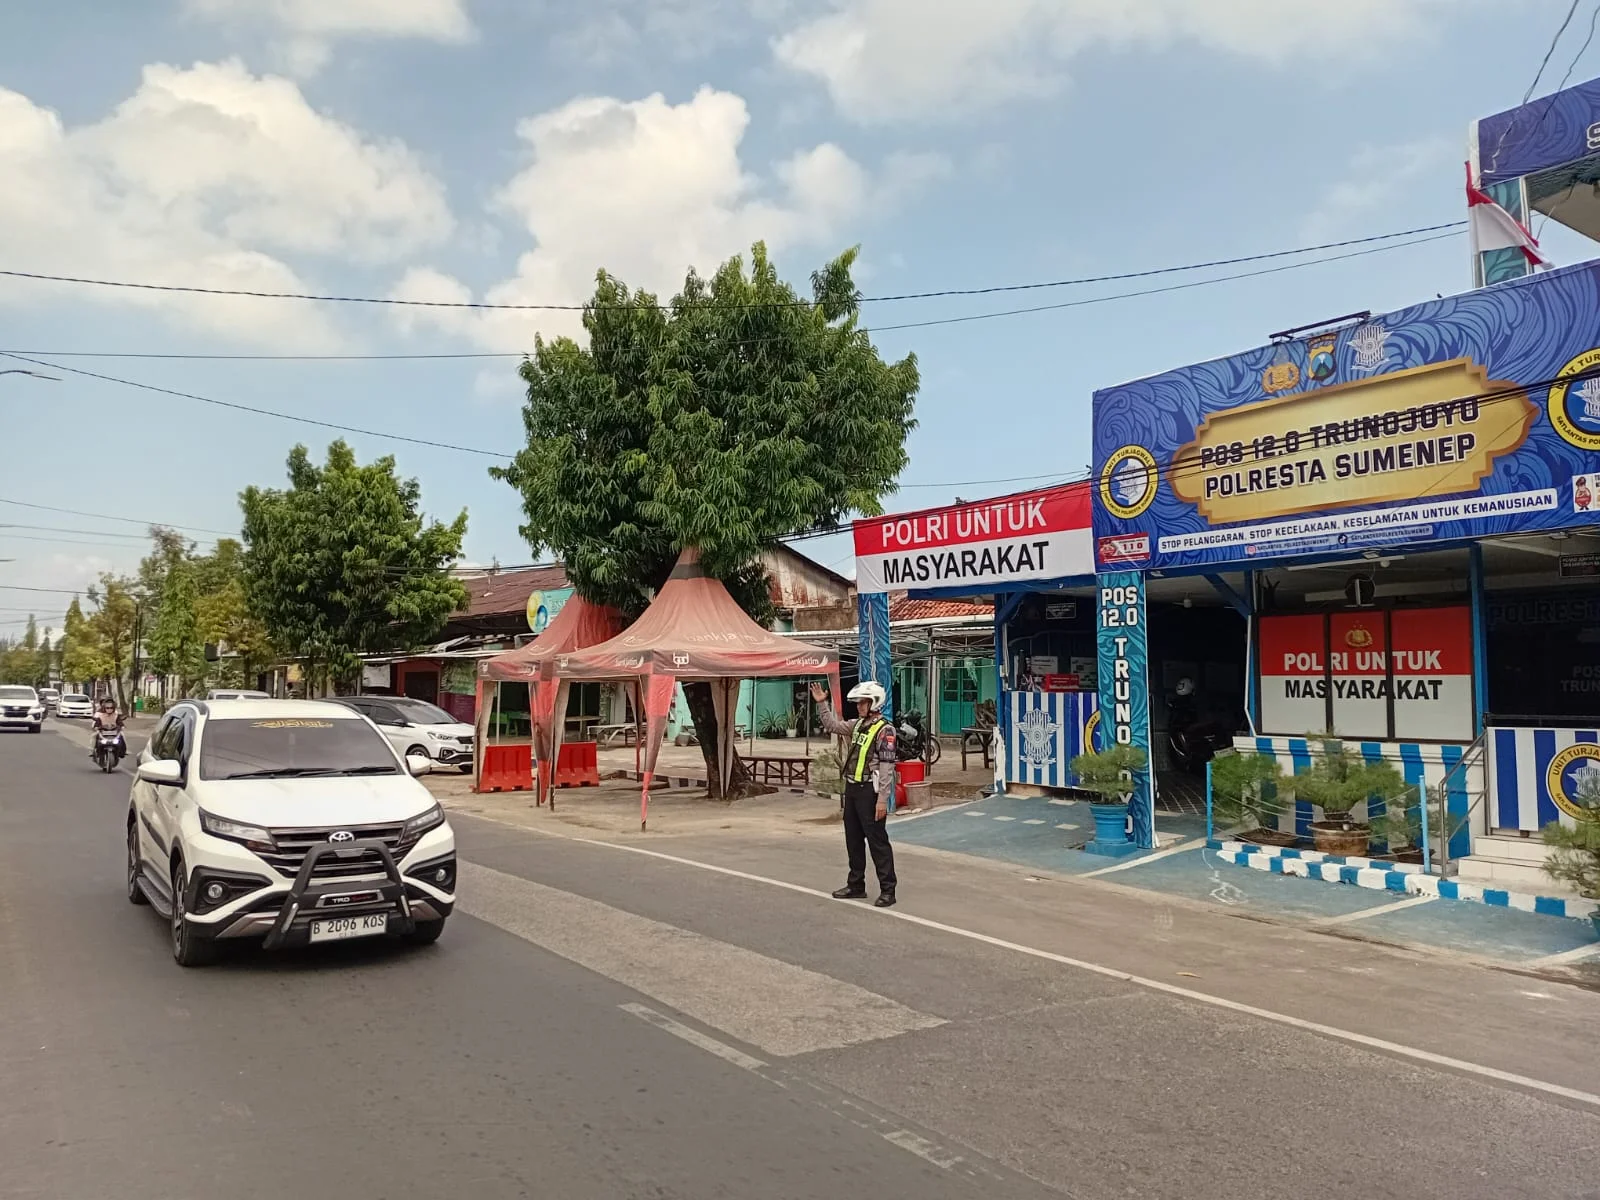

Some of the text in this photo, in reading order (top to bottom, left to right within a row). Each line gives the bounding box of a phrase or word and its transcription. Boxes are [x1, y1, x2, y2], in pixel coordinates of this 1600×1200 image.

[1200, 398, 1480, 469] POS 12.0 TRUNOJOYO
[1556, 415, 1588, 444] SATLANTAS
[1204, 432, 1477, 499] POLRESTA SUMENEP
[882, 497, 1048, 548] POLRI UNTUK
[1161, 539, 1182, 550] STOP
[1249, 528, 1273, 540] STOP
[1342, 508, 1419, 529] KESELAMATAN
[1421, 505, 1460, 519] UNTUK
[1463, 494, 1553, 515] KEMANUSIAAN
[1123, 542, 1143, 551] 110
[883, 541, 1049, 584] MASYARAKAT
[1100, 586, 1139, 606] POS
[1101, 607, 1138, 627] 12.0
[1284, 649, 1442, 672] POLRI UNTUK
[1284, 679, 1444, 700] MASYARAKAT
[1553, 756, 1568, 776] UNIT
[313, 922, 321, 935] B
[327, 917, 357, 933] 2096
[362, 914, 385, 929] KOS
